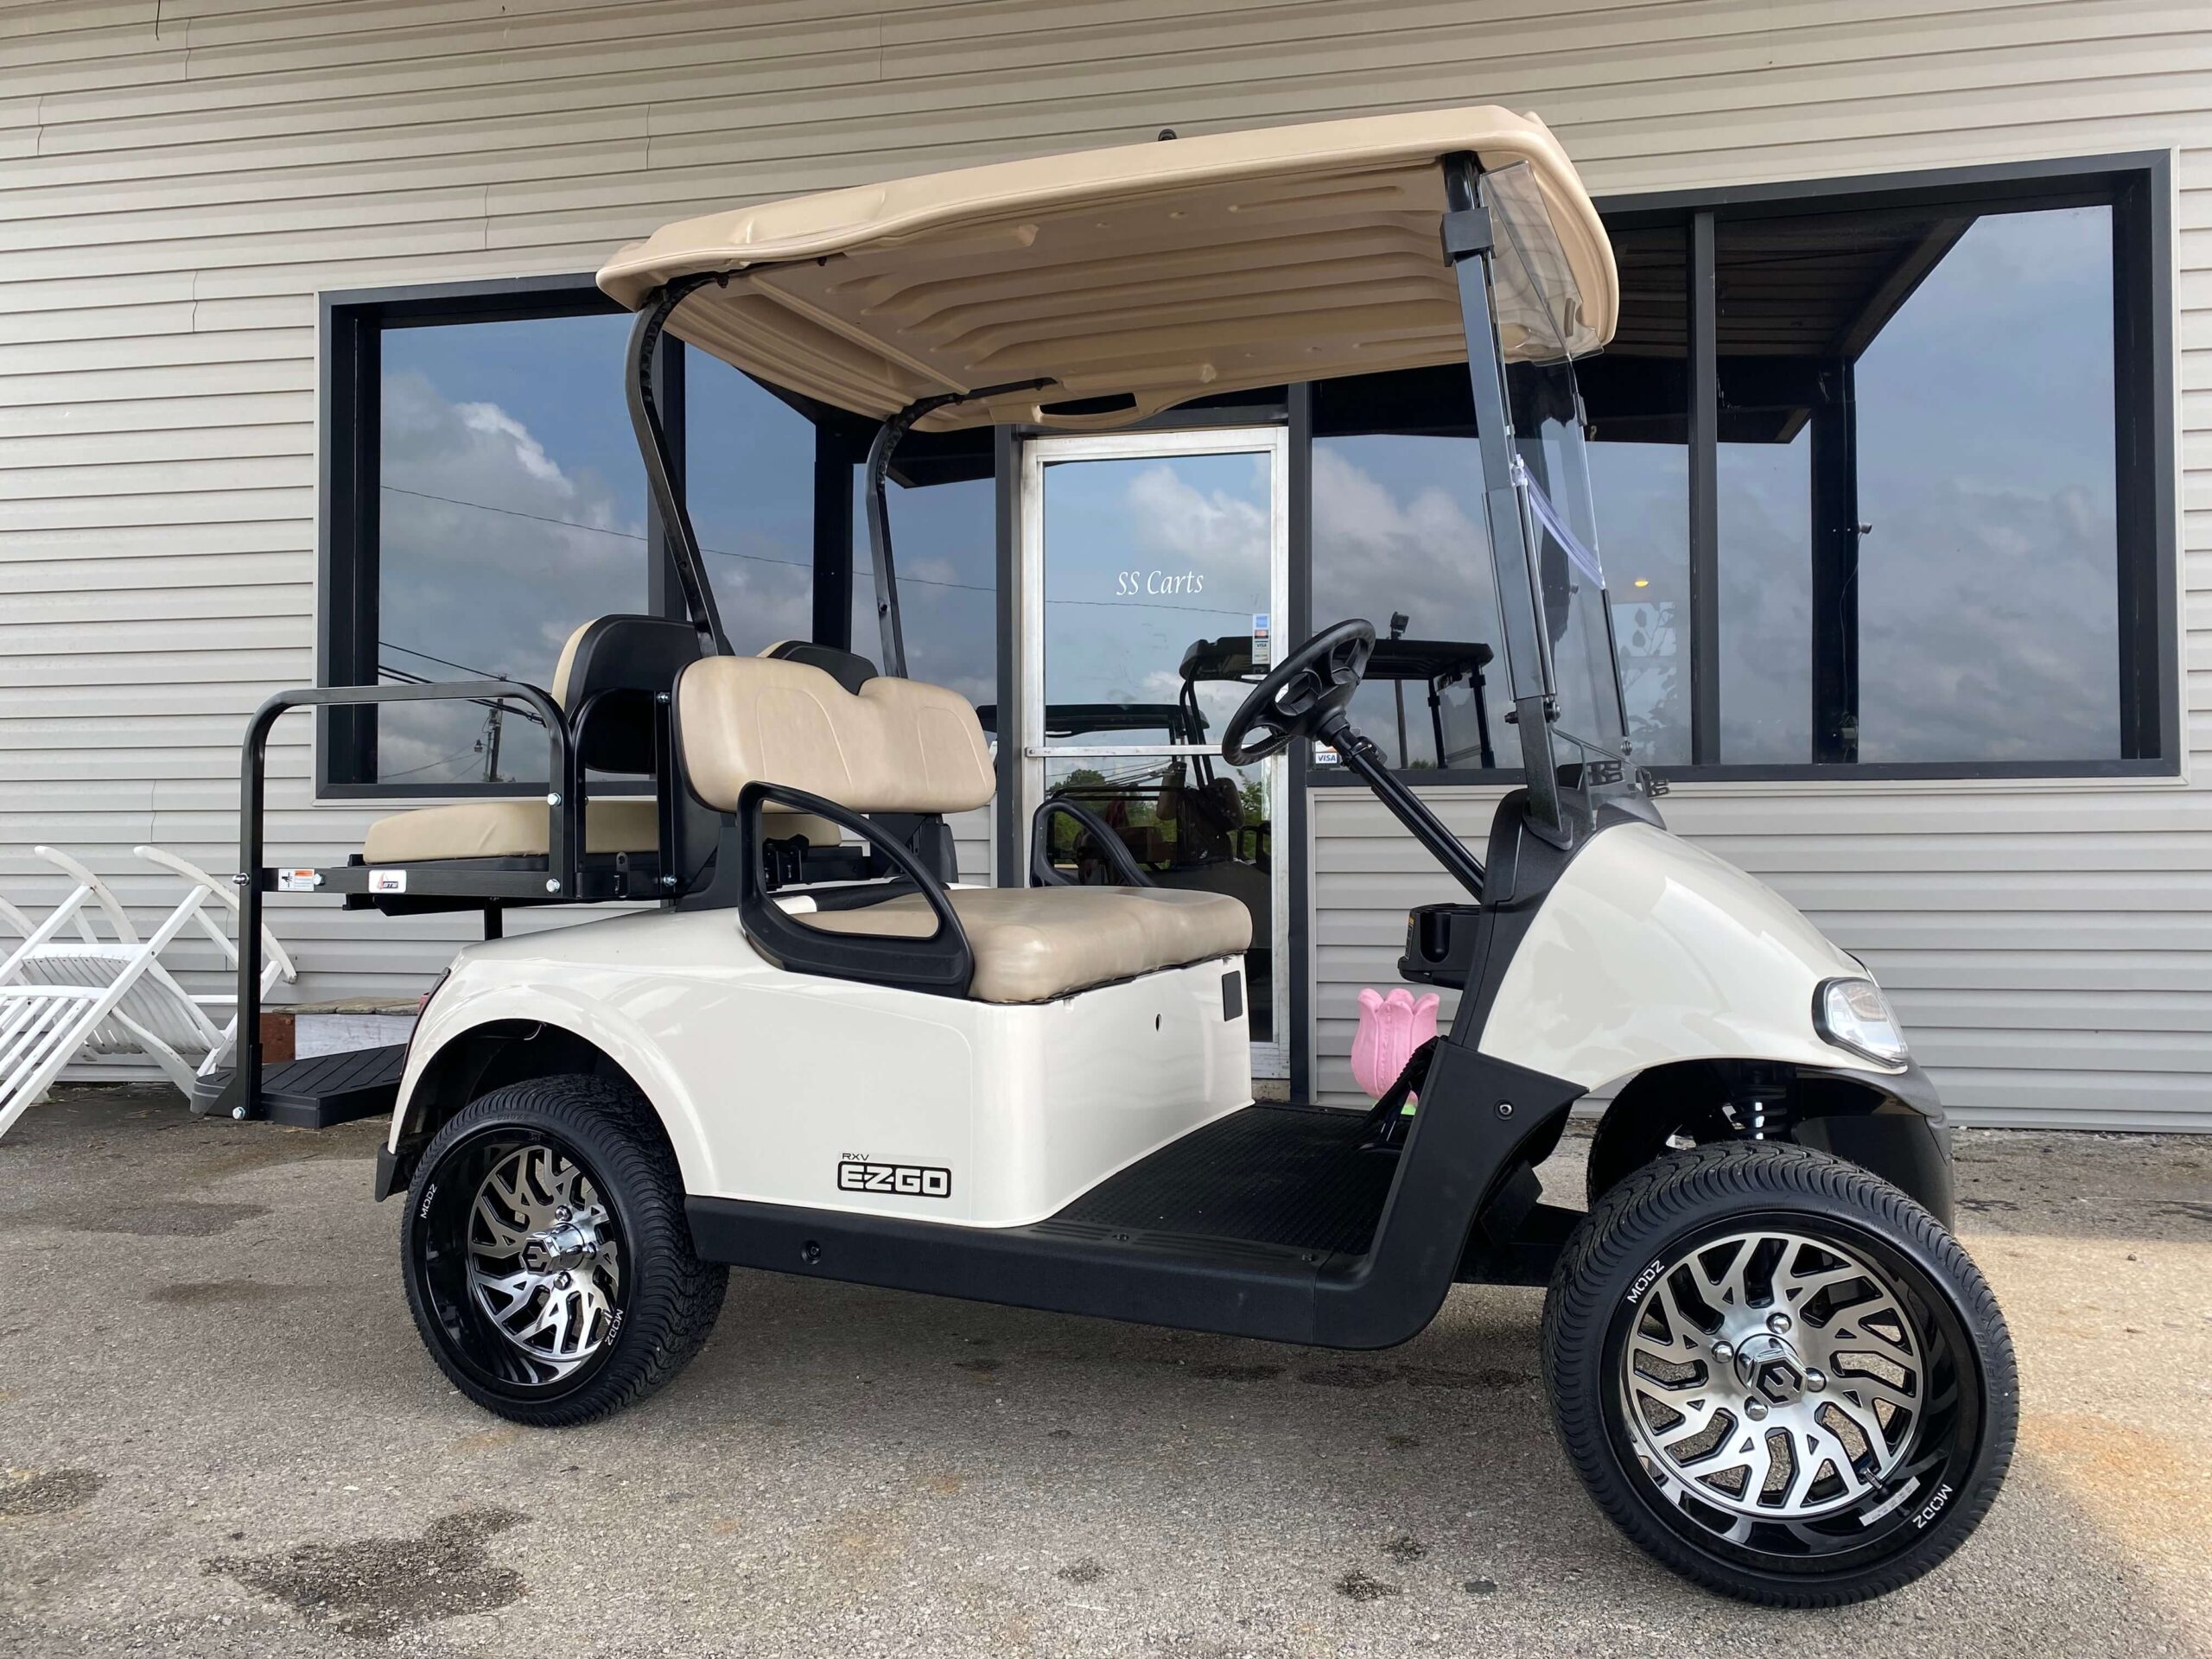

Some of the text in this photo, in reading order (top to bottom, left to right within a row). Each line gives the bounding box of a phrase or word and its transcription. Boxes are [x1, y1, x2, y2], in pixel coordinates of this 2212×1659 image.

[1116, 570, 1205, 595] SS Carts
[842, 1153, 870, 1161] RXV
[420, 1183, 438, 1218] MODZ
[1626, 1260, 1665, 1304] MODZ
[605, 1308, 624, 1346] MODZ
[1912, 1484, 1954, 1529] MODZ
